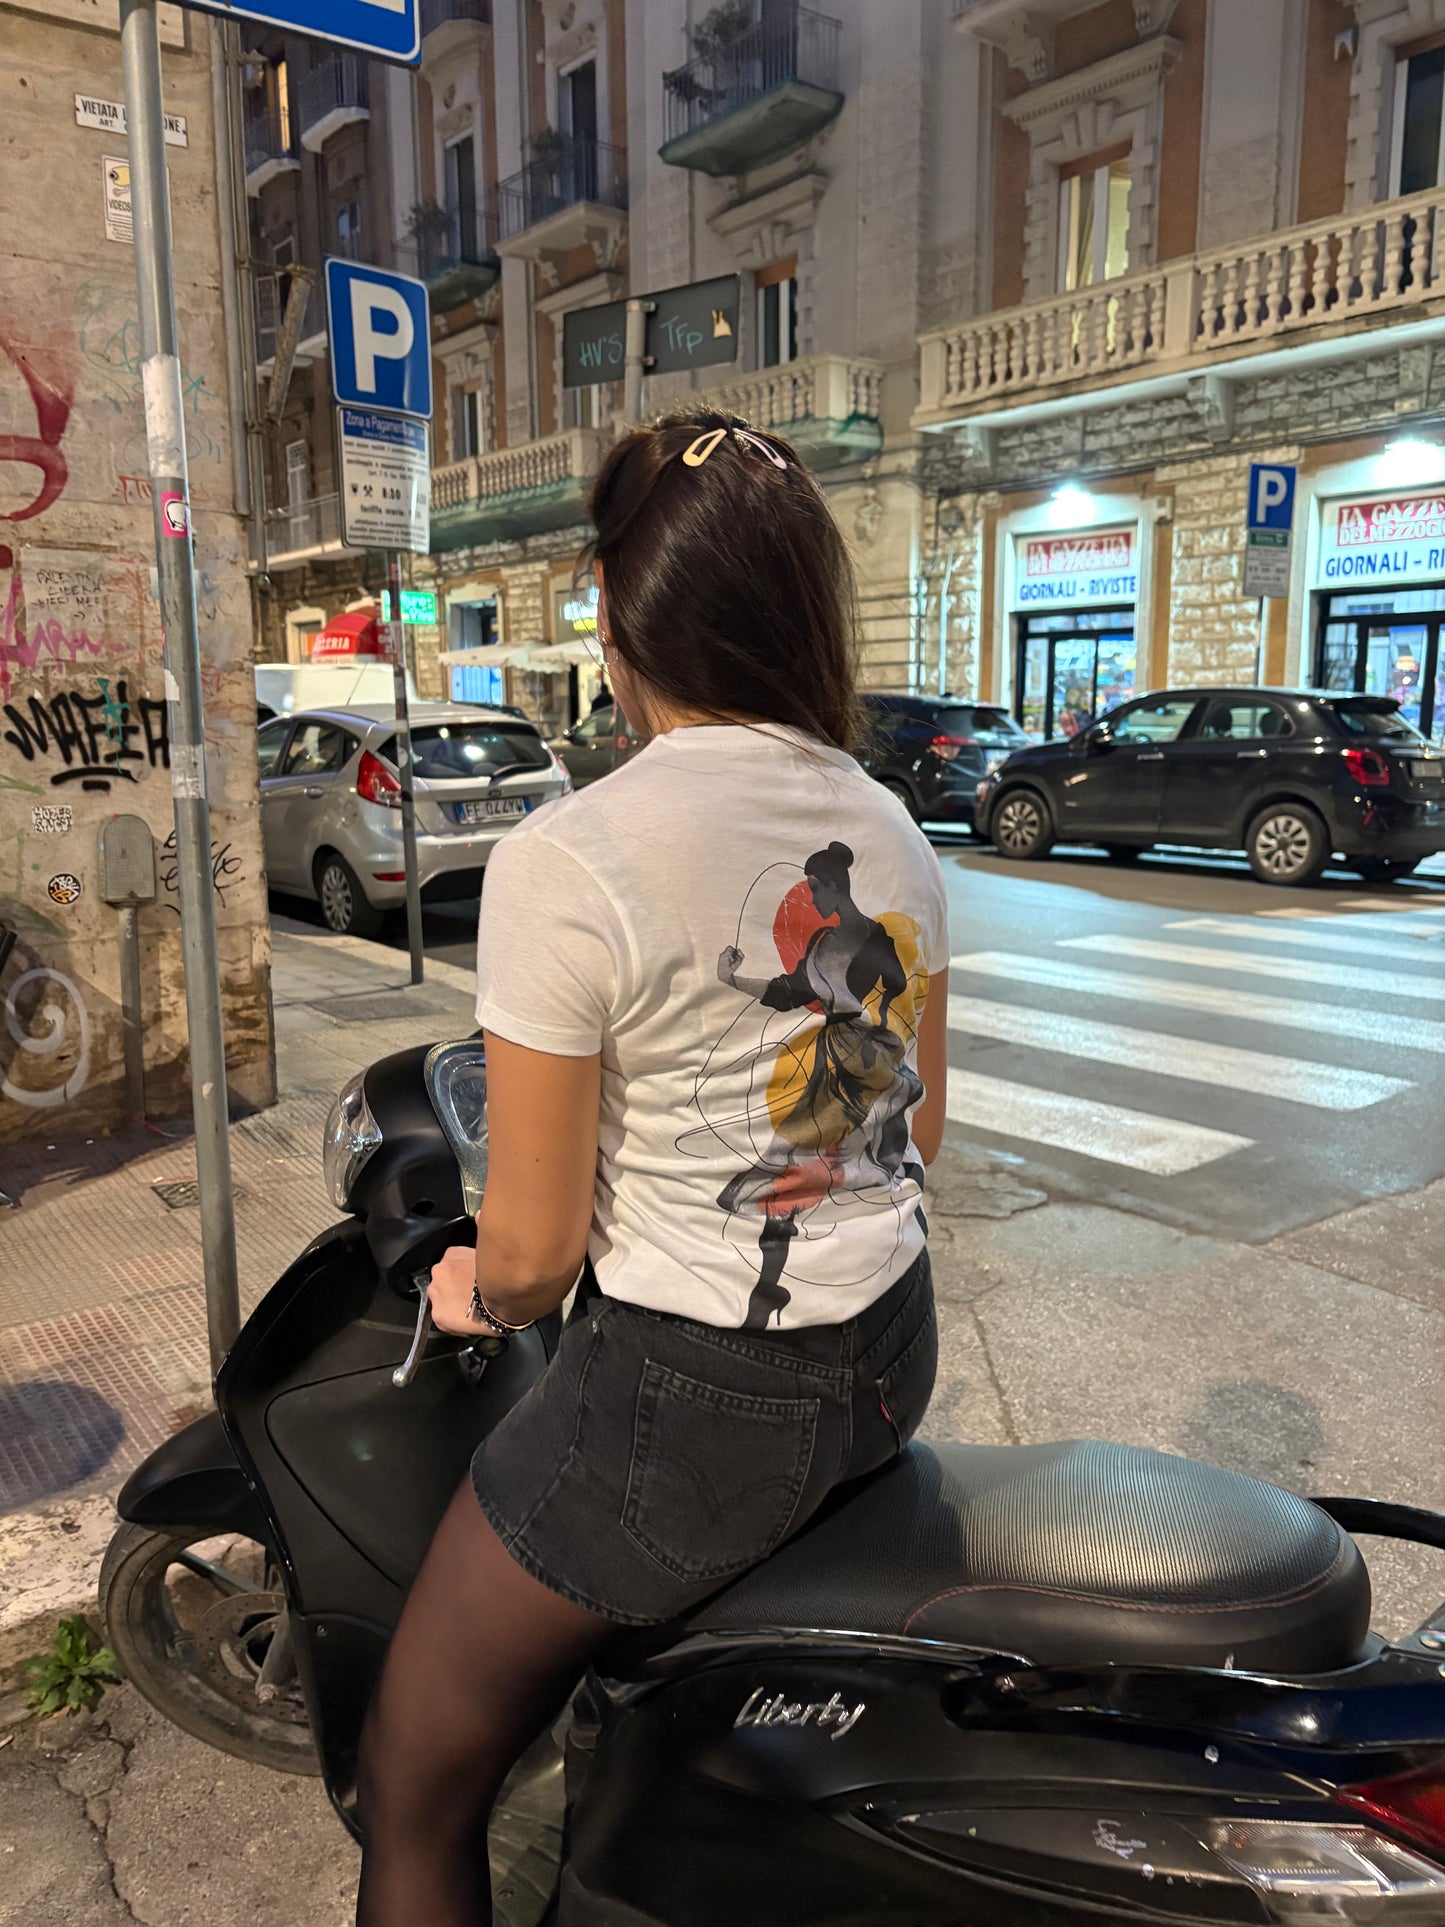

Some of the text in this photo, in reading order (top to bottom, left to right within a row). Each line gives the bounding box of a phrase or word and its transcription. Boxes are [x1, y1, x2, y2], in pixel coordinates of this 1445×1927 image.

[81, 99, 119, 119] VIETATA
[349, 277, 414, 394] P
[1256, 469, 1288, 523] P
[1342, 508, 1367, 528] LA
[1369, 519, 1445, 543] MEZZOGI
[1325, 550, 1408, 577] GIORNALI
[1020, 580, 1076, 600] GIORNALI
[1088, 576, 1137, 596] RIVISTE
[3, 680, 171, 769] MAFIA
[734, 1686, 866, 1741] Liberty
